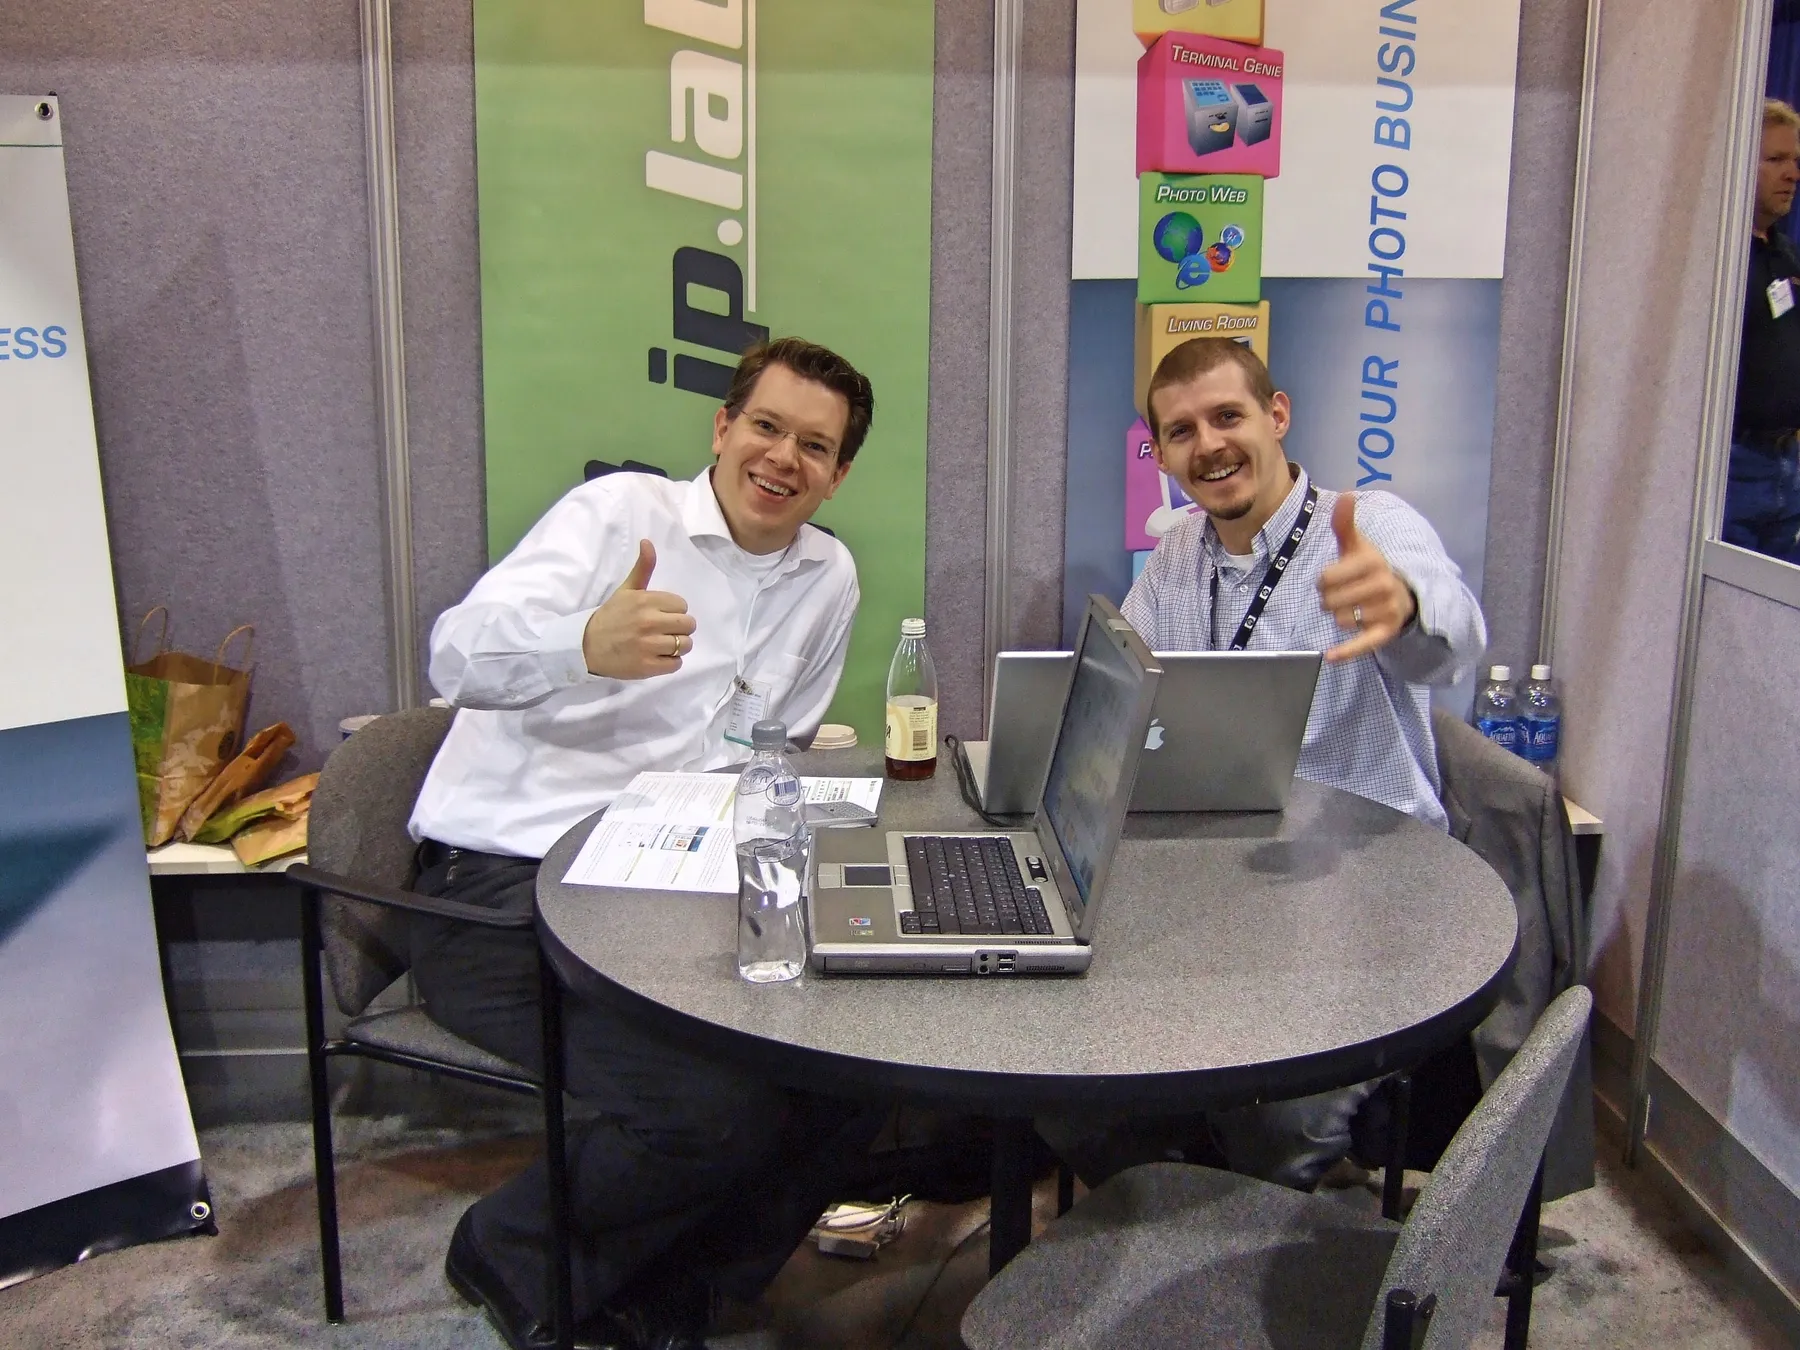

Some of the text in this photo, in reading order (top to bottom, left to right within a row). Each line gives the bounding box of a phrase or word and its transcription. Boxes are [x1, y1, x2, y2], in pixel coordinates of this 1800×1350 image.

[1172, 44, 1282, 77] TERMINAL GENIE
[1156, 185, 1247, 203] PHOTO WEB
[1365, 164, 1409, 332] PHOTO
[1167, 315, 1258, 333] LIVING ROOM
[1356, 355, 1399, 488] YOUR
